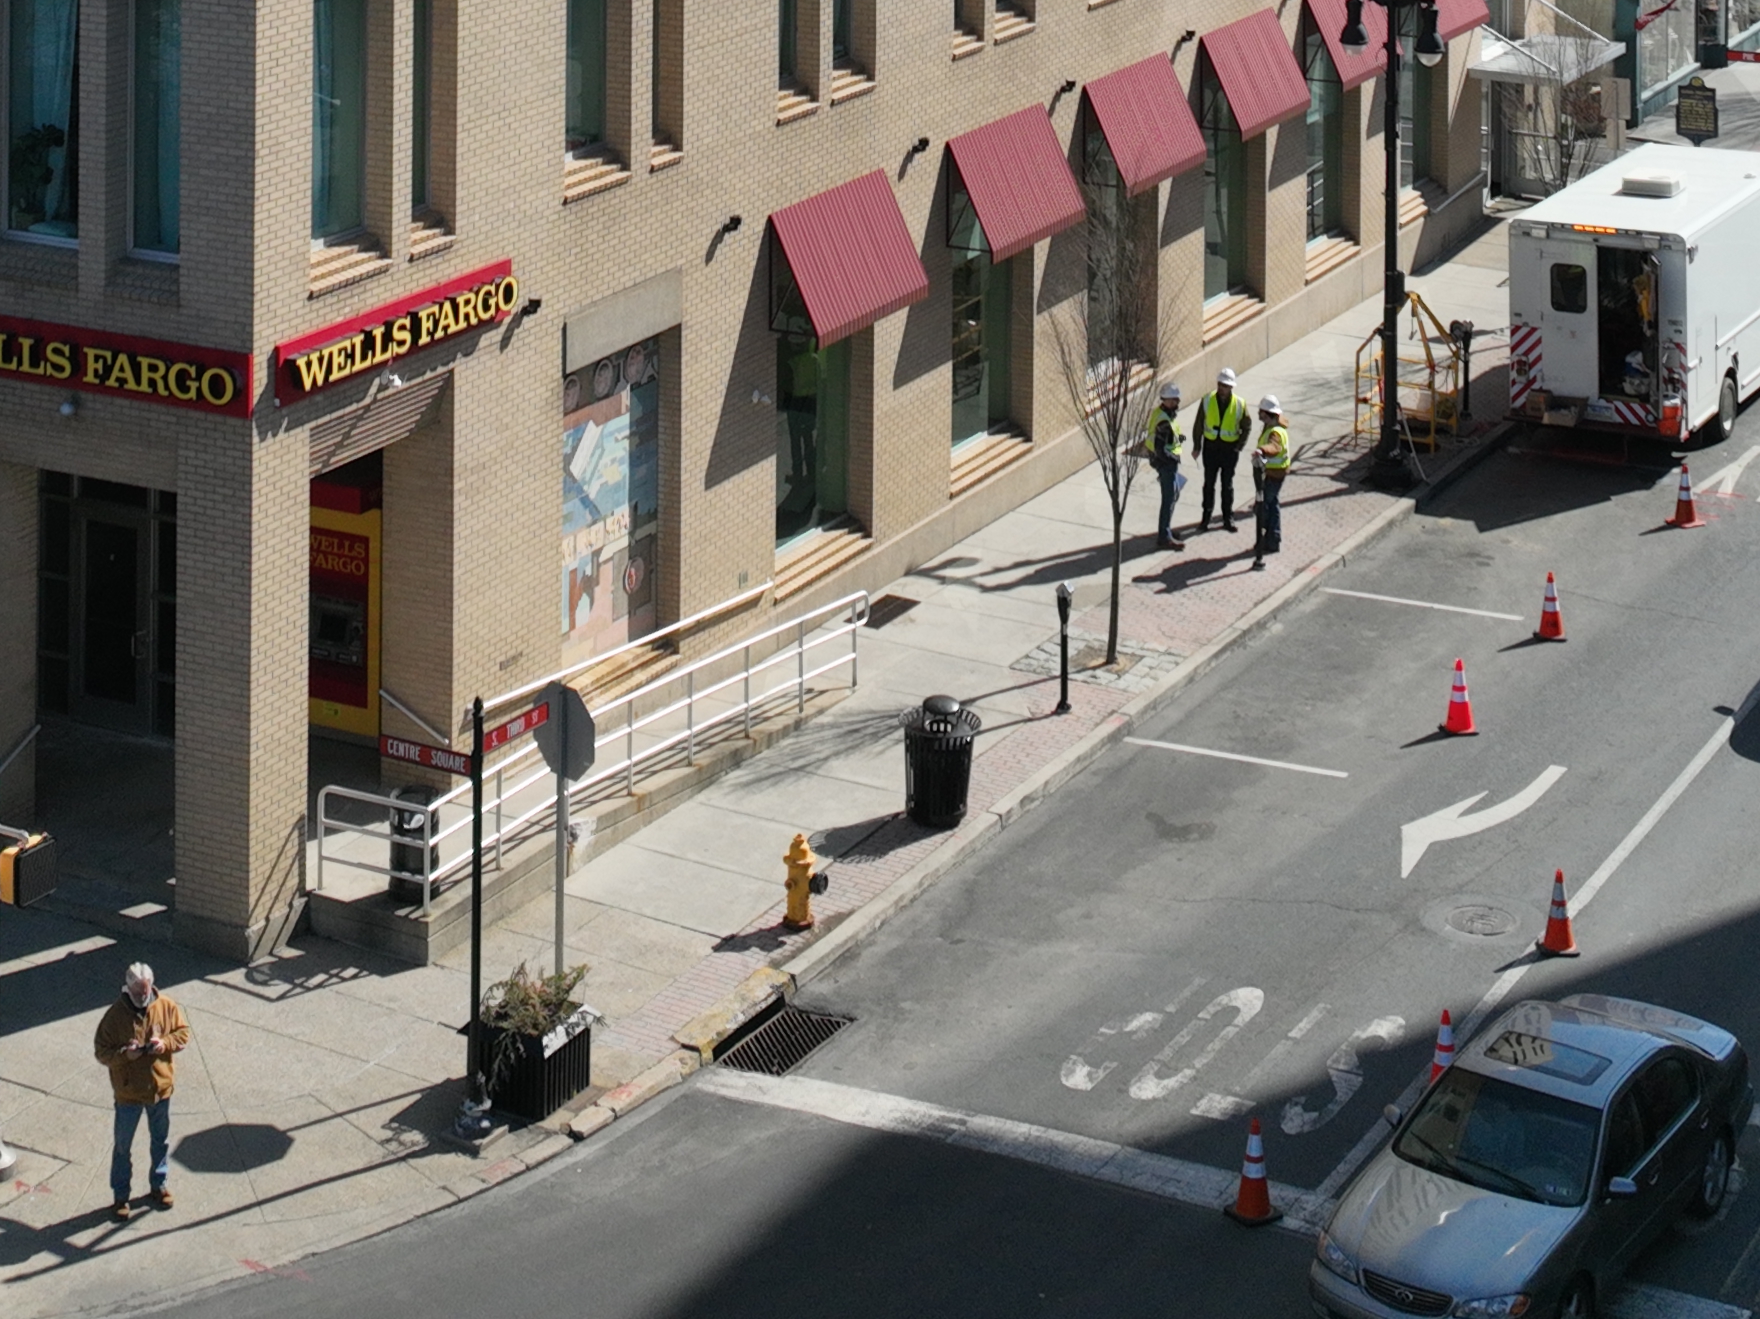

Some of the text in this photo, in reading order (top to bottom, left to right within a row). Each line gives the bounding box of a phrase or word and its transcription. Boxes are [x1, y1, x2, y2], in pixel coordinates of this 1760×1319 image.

[296, 275, 519, 392] WELLS FARGO
[82, 346, 234, 406] FARGO
[506, 718, 525, 739] THIRD
[532, 709, 539, 724] ST
[387, 739, 466, 773] CENTRE SQUARE
[1060, 975, 1405, 1134] STOP
